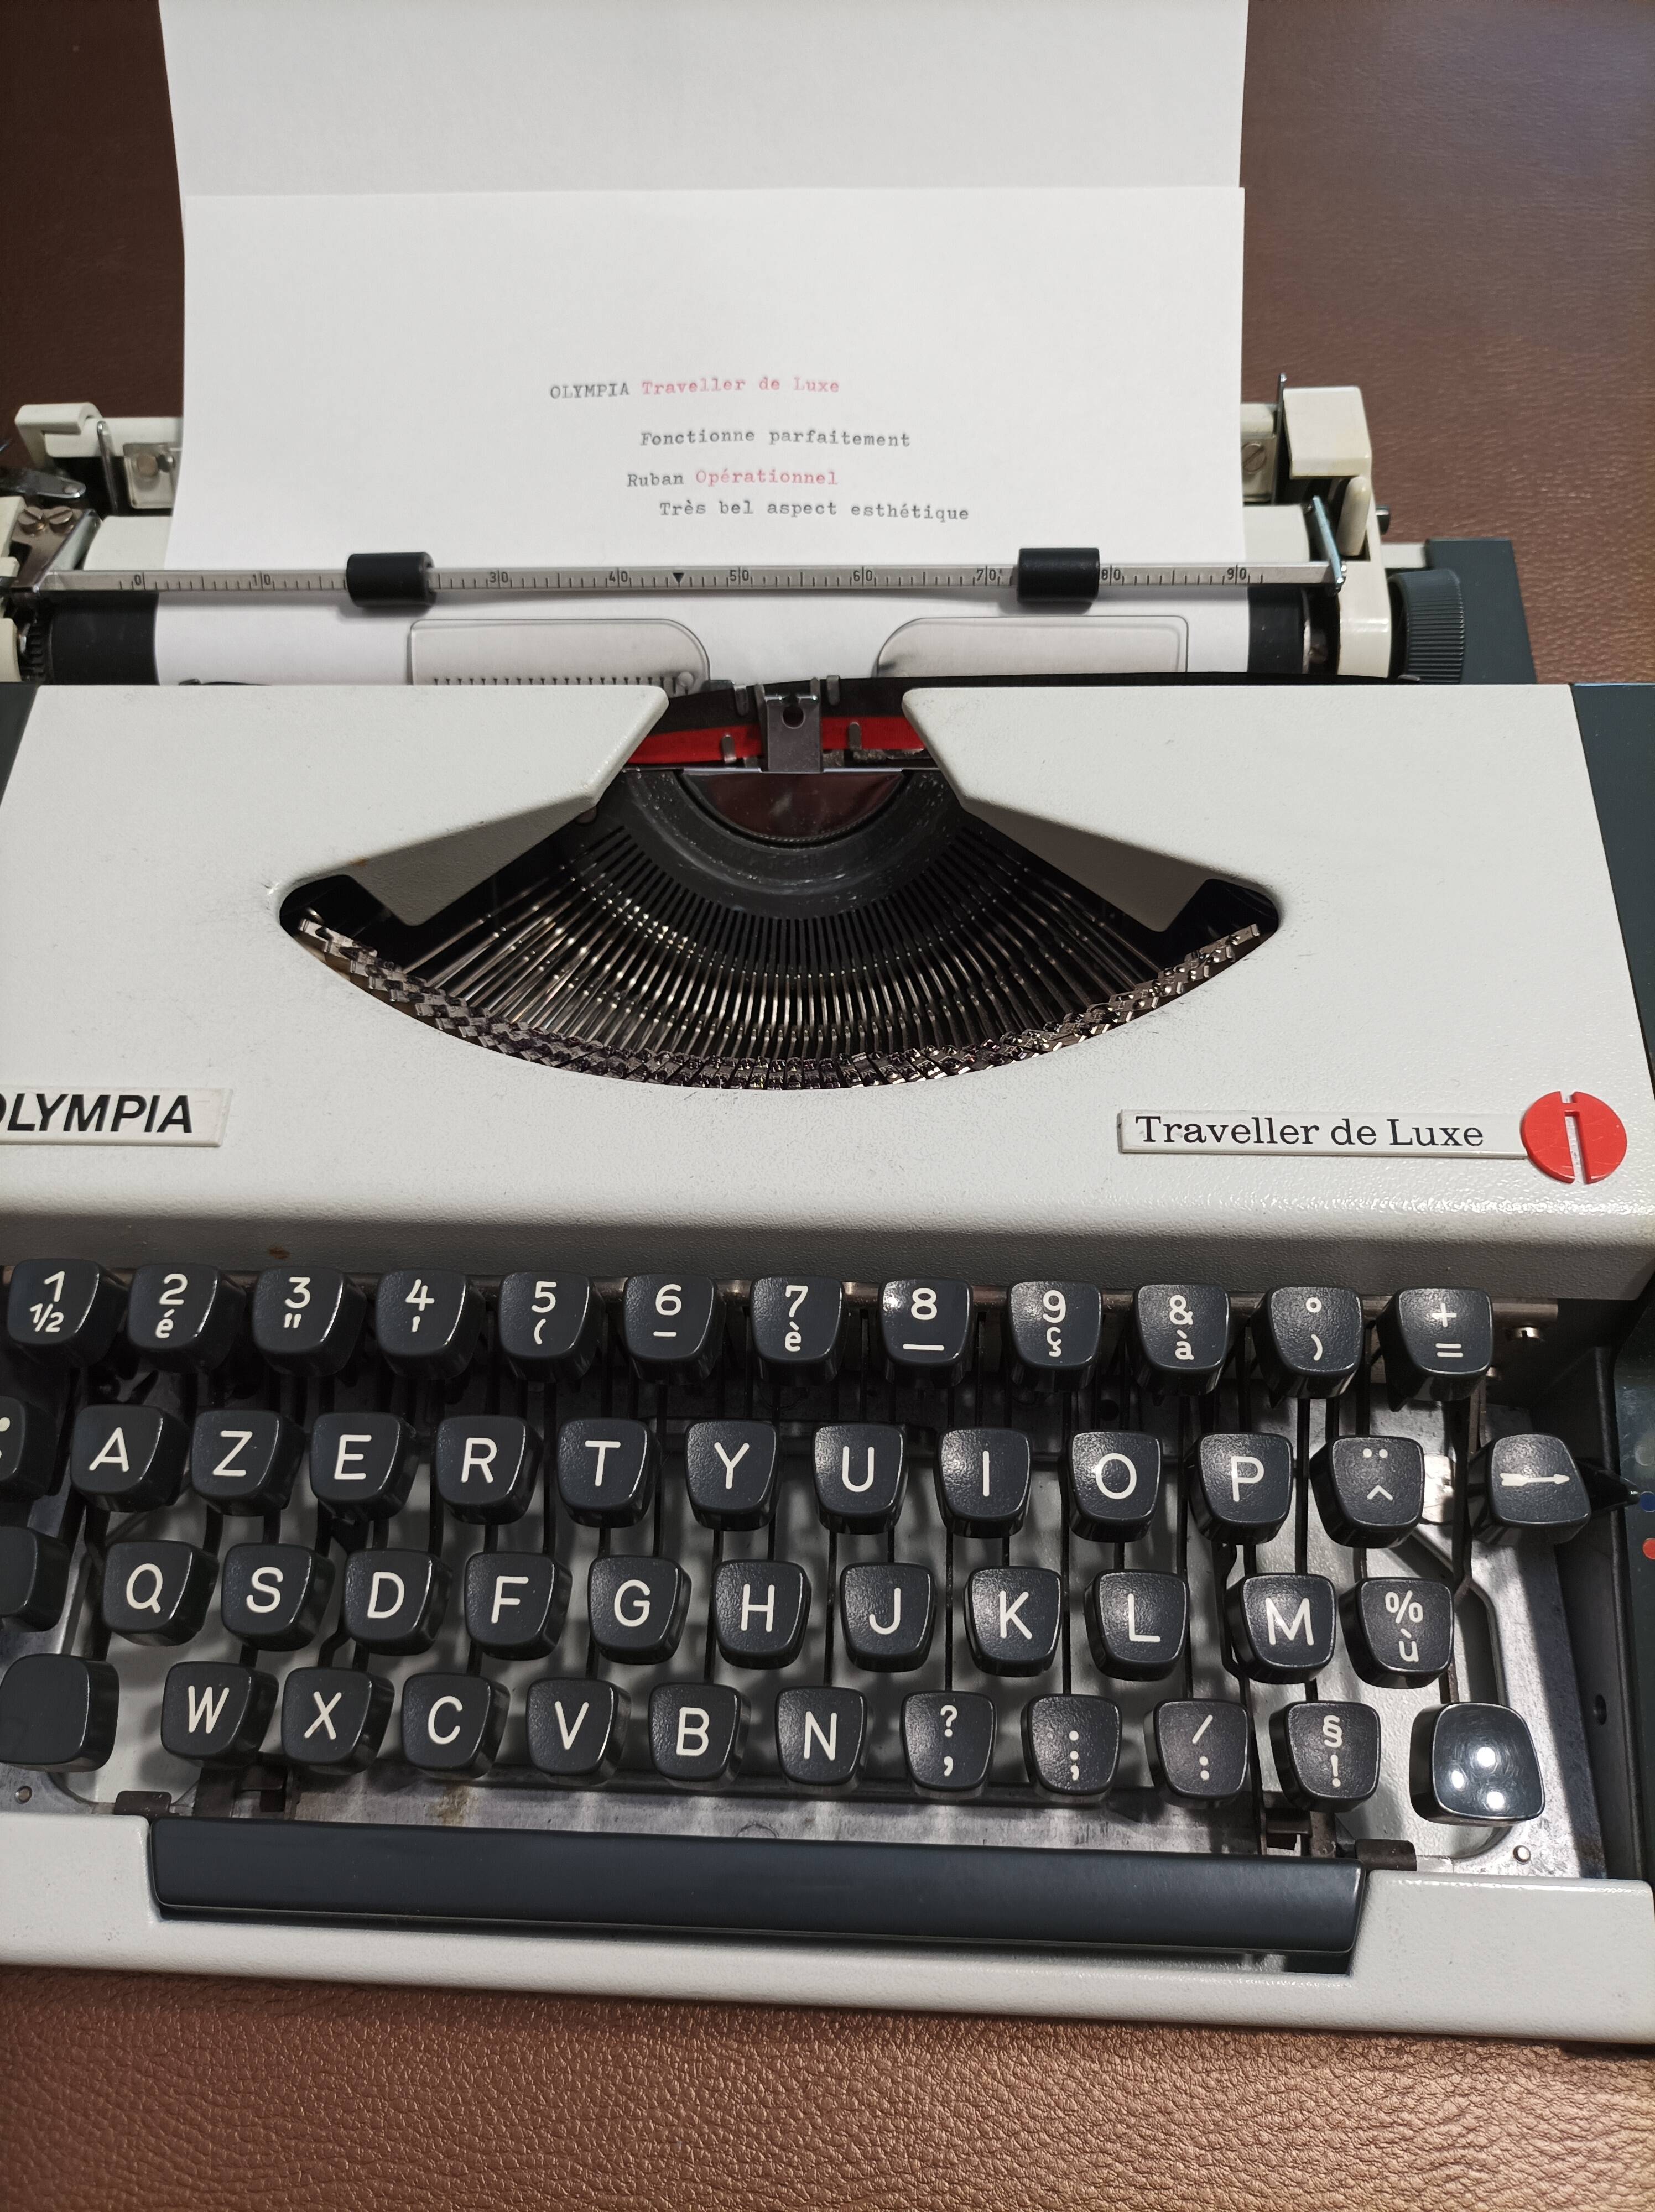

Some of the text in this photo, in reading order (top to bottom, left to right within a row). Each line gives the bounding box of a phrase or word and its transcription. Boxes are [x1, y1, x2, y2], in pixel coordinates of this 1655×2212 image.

[550, 376, 839, 399] OLYMPIA Traveller de Luxe
[641, 429, 910, 447] Fonctionne parfaitement
[627, 468, 837, 487] Ruban Opérationnel
[660, 499, 969, 523] Très bel aspect esthétique
[134, 568, 1247, 586] 0 10 30 40 50 60 70 80 90
[1135, 1115, 1483, 1146] Traveller de Luxe
[44, 1271, 65, 1302] 1
[159, 1273, 188, 1305] 2
[285, 1276, 311, 1309] 3
[405, 1279, 435, 1311] 4
[532, 1281, 557, 1313] 5
[655, 1284, 682, 1316] 6
[785, 1285, 809, 1318] 7
[910, 1287, 938, 1321] 8
[1042, 1290, 1066, 1323] 9
[155, 1308, 175, 1338] é
[1169, 1295, 1194, 1326] &
[784, 1321, 802, 1352] è
[1046, 1327, 1062, 1357] ç
[1175, 1329, 1194, 1360] à
[89, 1427, 129, 1472] A
[212, 1430, 253, 1477] Z
[334, 1434, 372, 1480] E
[461, 1437, 497, 1483] R
[585, 1440, 621, 1486] T
[714, 1442, 750, 1489] Y
[842, 1446, 875, 1493] U
[982, 1450, 990, 1497] I
[1094, 1452, 1137, 1500] O
[1230, 1455, 1264, 1503] P
[126, 1563, 163, 1613] Q
[247, 1567, 283, 1613] S
[367, 1572, 405, 1619] D
[491, 1575, 529, 1624] F
[614, 1579, 650, 1627] G
[741, 1583, 775, 1632] H
[1385, 1590, 1423, 1624] %
[869, 1587, 901, 1635] J
[998, 1590, 1033, 1640] K
[1127, 1593, 1161, 1642] L
[1264, 1597, 1314, 1646] M
[1398, 1627, 1419, 1662] ù
[188, 1685, 230, 1734] W
[304, 1691, 342, 1740] X
[428, 1695, 463, 1744] C
[555, 1701, 589, 1750] V
[676, 1707, 710, 1756] B
[940, 1705, 957, 1737] ?
[803, 1711, 837, 1761] N
[1323, 1715, 1343, 1750] §
[1330, 1754, 1341, 1787] !
